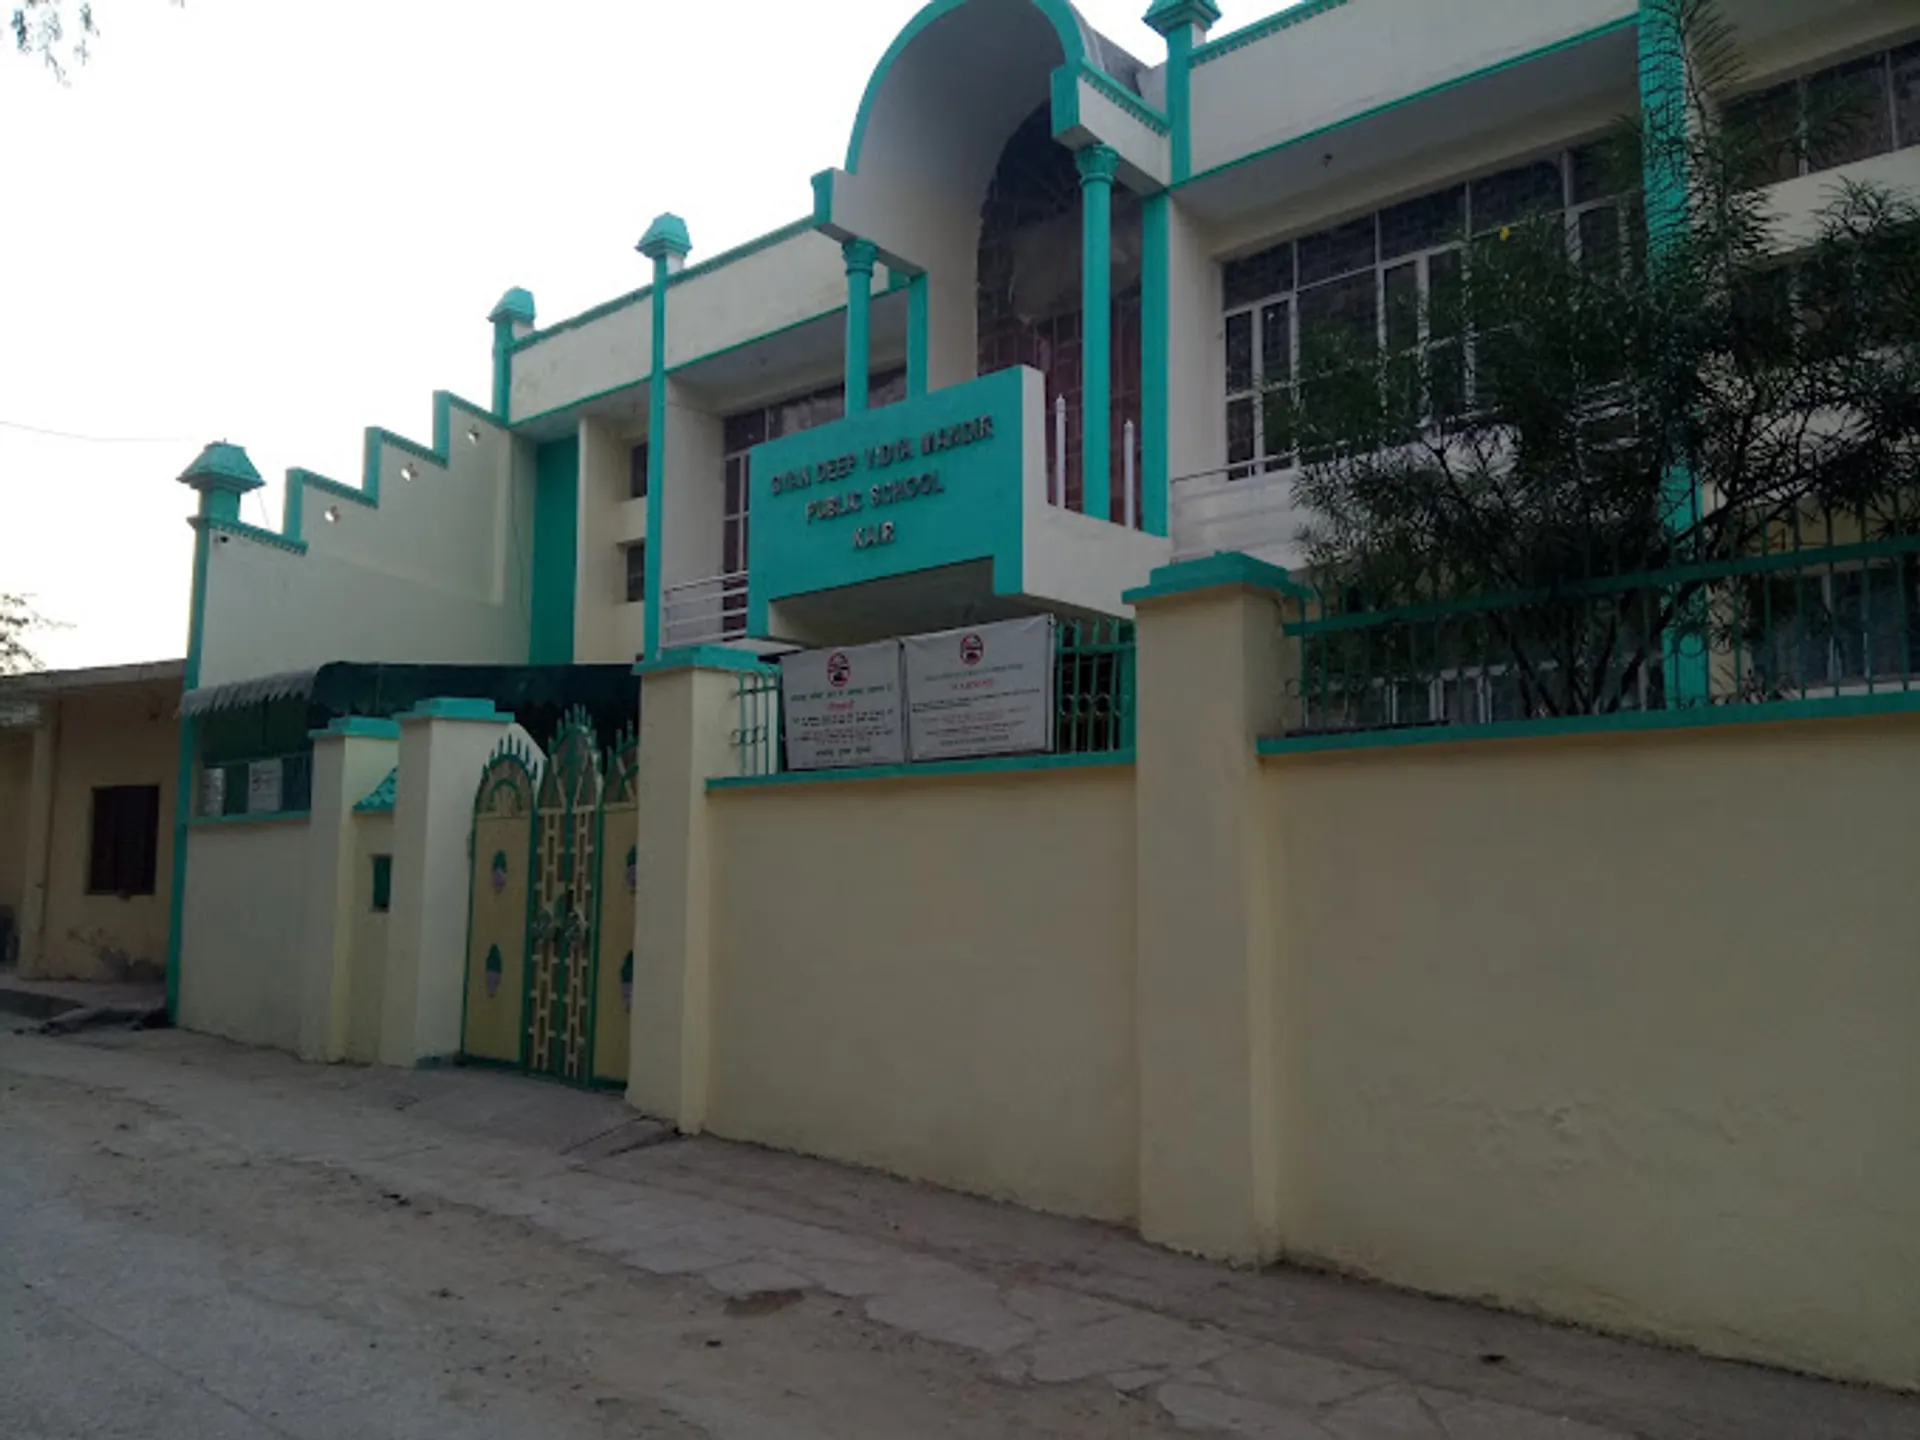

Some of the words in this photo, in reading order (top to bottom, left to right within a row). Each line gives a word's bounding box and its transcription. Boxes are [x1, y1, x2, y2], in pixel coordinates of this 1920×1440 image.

[817, 453, 857, 484] DEEP
[921, 414, 995, 456] MANDIR
[806, 491, 864, 523] PUBLIC
[870, 470, 945, 507] SCHOOL
